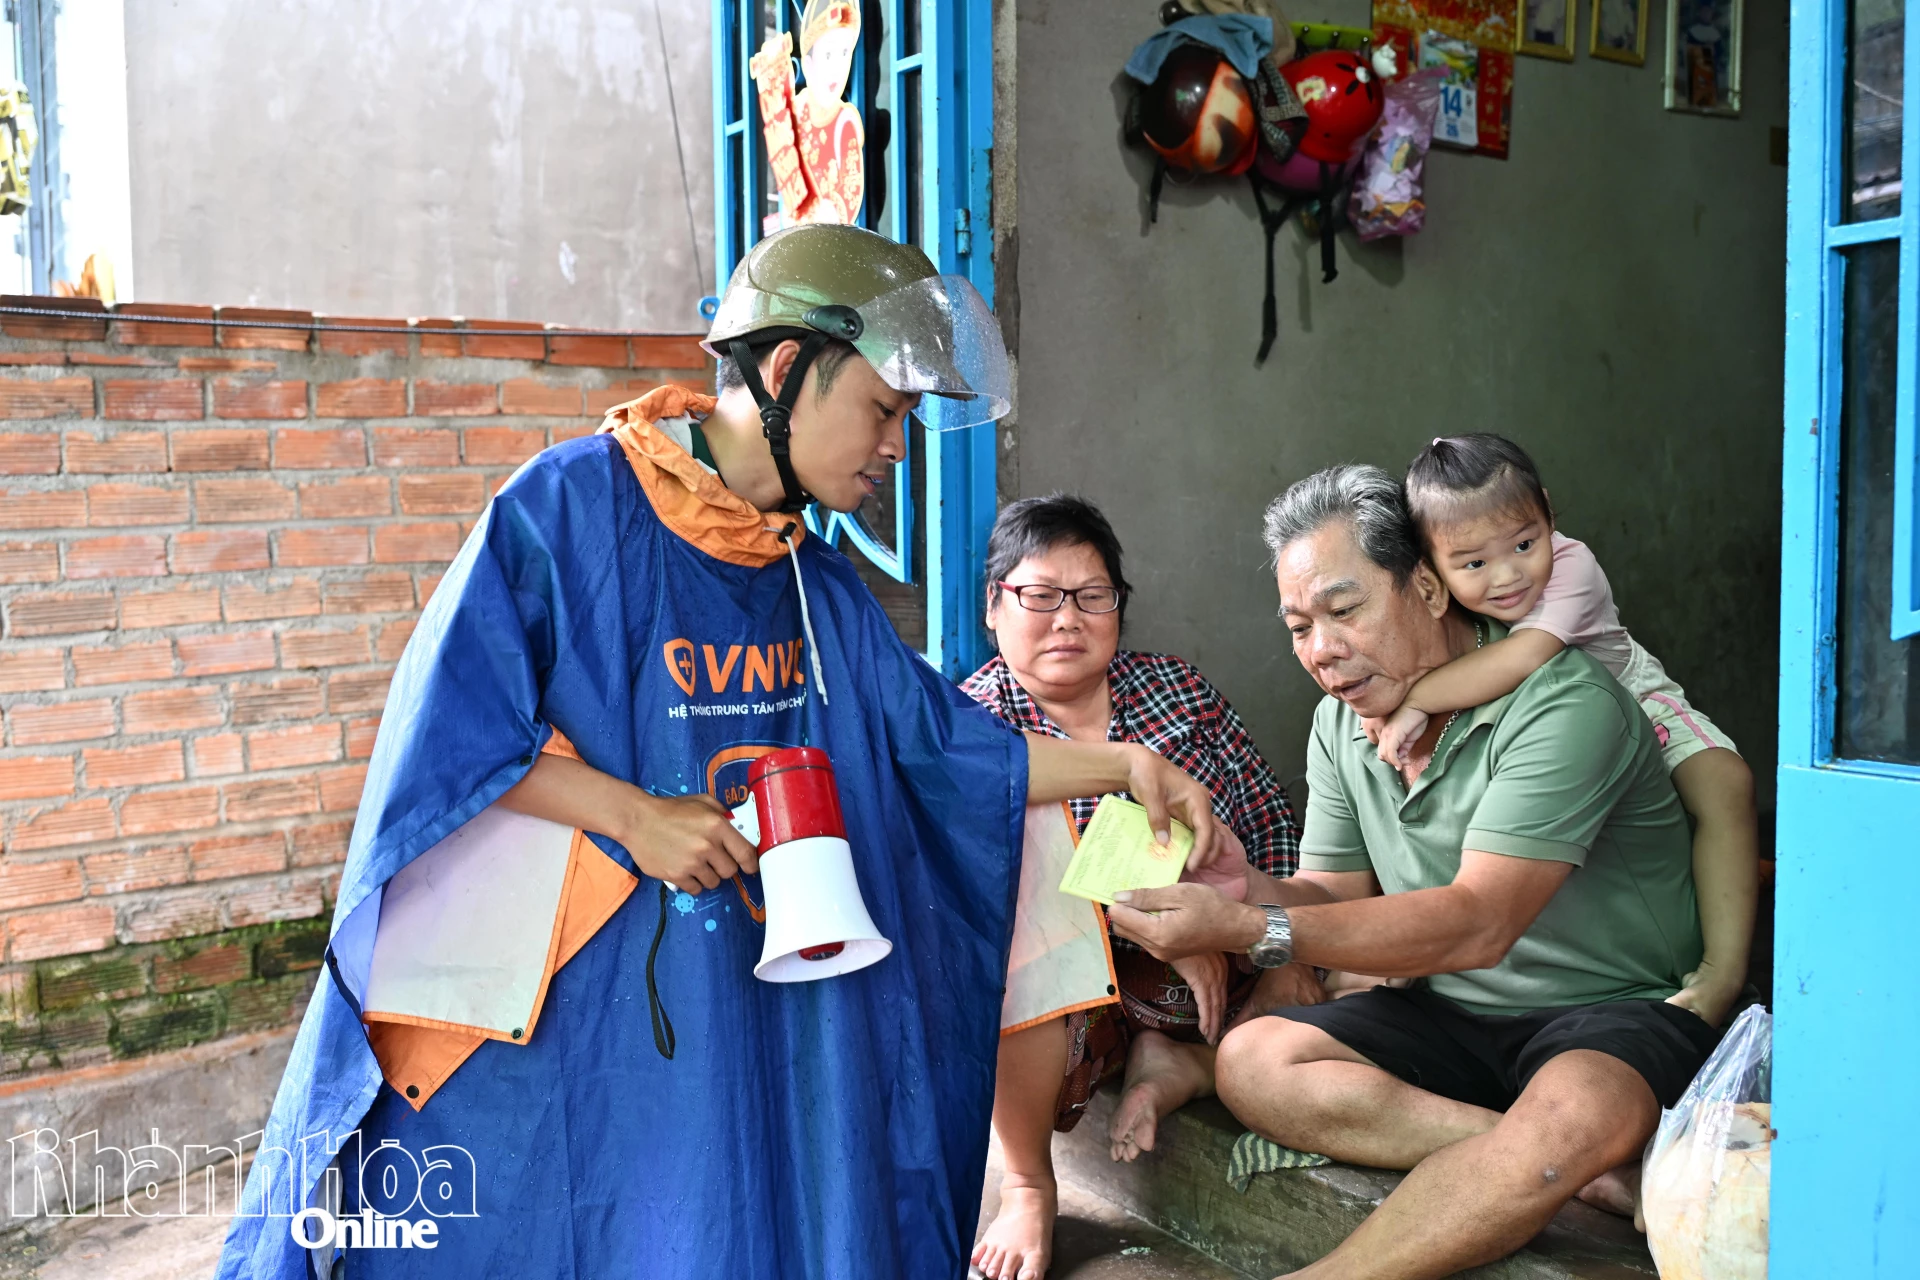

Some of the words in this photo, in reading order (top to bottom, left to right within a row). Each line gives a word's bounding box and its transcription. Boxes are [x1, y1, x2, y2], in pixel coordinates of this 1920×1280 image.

[1440, 86, 1462, 118] 14
[702, 638, 804, 692] VNVC
[669, 704, 688, 719] HỆ
[711, 704, 748, 715] TRUNG
[752, 701, 774, 714] TÂM
